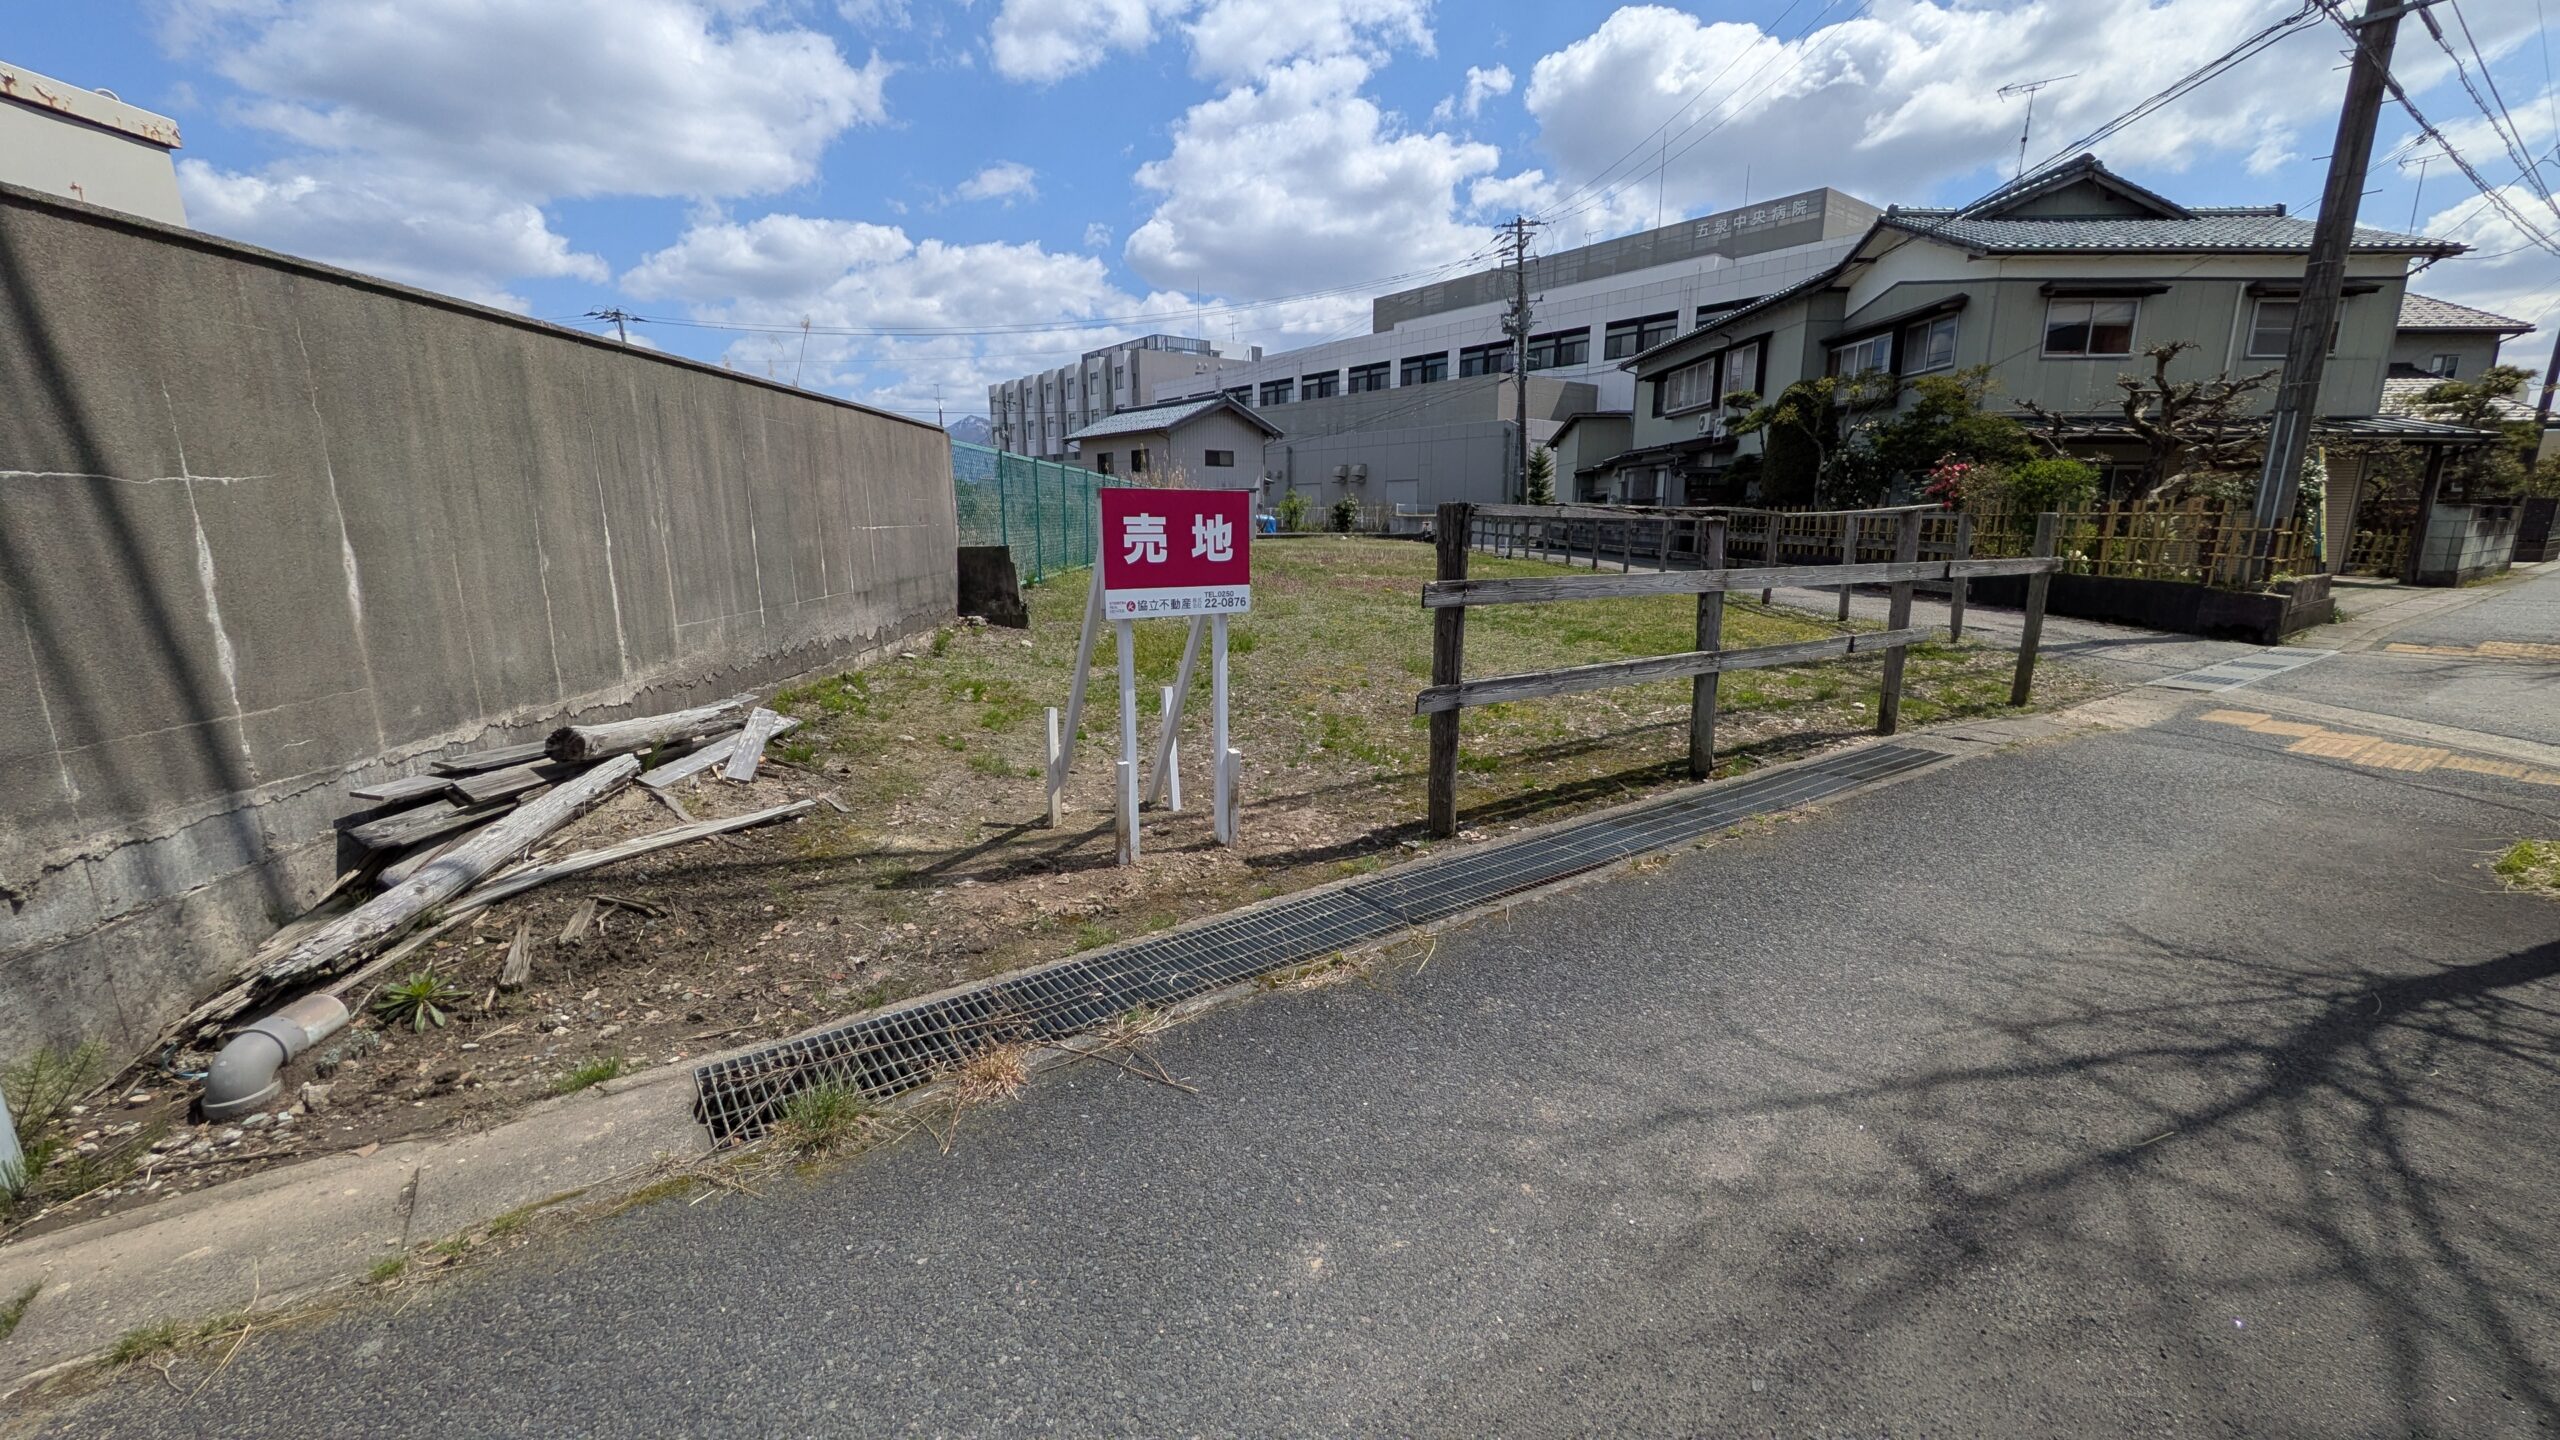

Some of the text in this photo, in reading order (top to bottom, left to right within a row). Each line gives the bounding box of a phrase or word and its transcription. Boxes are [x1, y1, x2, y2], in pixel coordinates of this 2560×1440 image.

[1695, 201, 1807, 238] 五泉中央病院
[1123, 513, 1233, 565] 売地
[1137, 599, 1191, 611] 協立不動産
[1204, 597, 1246, 608] 22-0876
